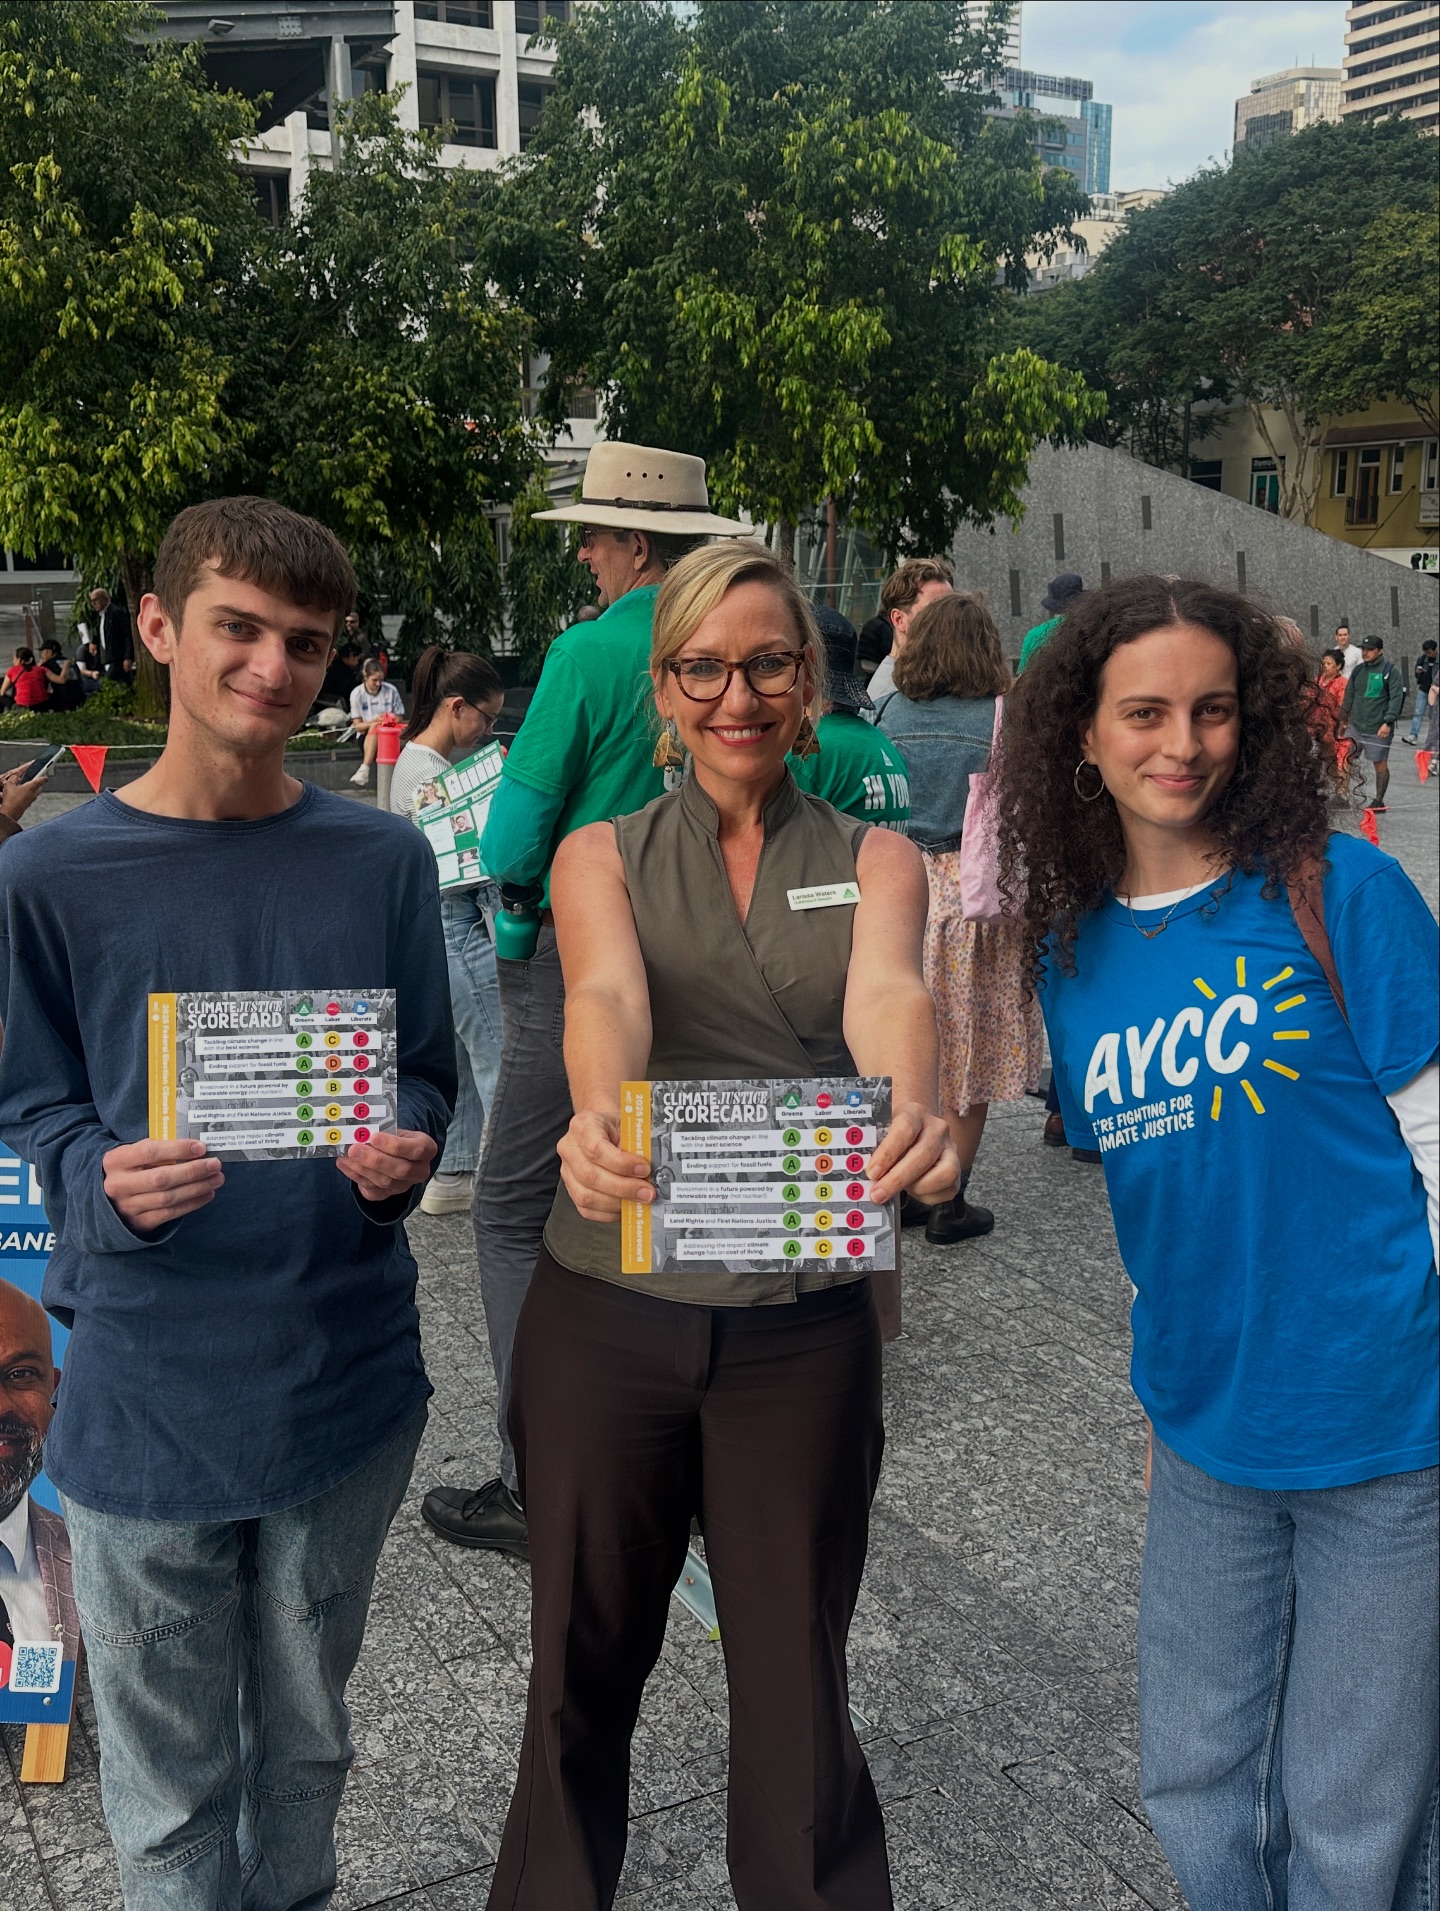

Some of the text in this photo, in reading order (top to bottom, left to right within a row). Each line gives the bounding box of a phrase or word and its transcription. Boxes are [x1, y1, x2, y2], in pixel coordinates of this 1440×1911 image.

[862, 774, 886, 810] IN
[187, 1000, 283, 1014] CLIMATE JUSTICE
[188, 1012, 283, 1030] SCORECARD
[300, 1036, 308, 1044] A
[328, 1036, 336, 1044] C
[1084, 994, 1258, 1114] AYCC
[300, 1060, 308, 1068] A
[300, 1083, 364, 1092] A B F
[663, 1091, 768, 1106] CLIMATE JUSTICE
[301, 1107, 365, 1116] A C F
[663, 1105, 768, 1123] SCORECARD
[1116, 1100, 1166, 1129] FIGHTING
[1170, 1094, 1194, 1113] FOR
[1142, 1110, 1195, 1140] JUSTICE
[301, 1131, 365, 1141] A C F
[787, 1131, 858, 1142] A C F
[787, 1158, 858, 1169] A D F
[787, 1186, 858, 1197] A B F
[788, 1215, 858, 1225] A C F
[788, 1242, 859, 1254] A C F
